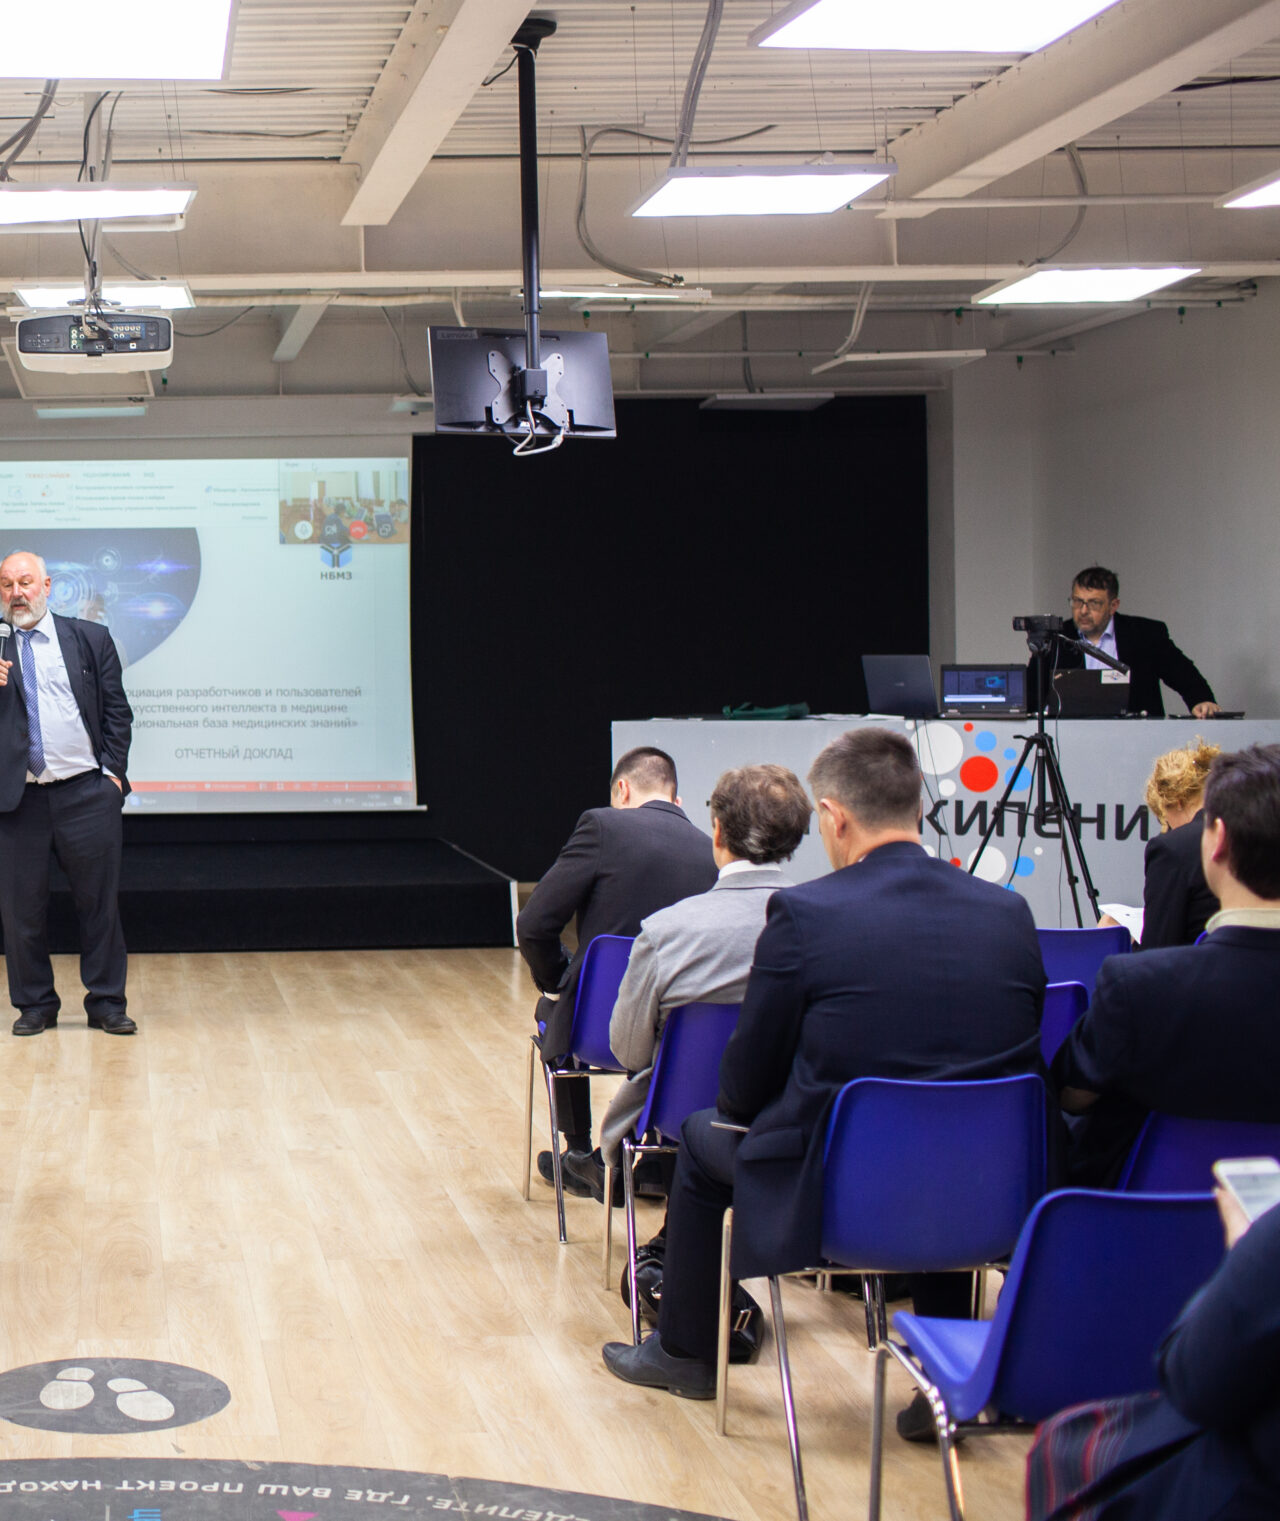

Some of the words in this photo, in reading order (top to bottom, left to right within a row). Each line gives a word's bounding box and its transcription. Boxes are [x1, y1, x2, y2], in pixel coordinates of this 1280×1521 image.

[320, 571, 353, 581] НБМЗ
[126, 688, 173, 700] оциация
[176, 686, 261, 700] разработчиков
[276, 686, 362, 698] пользователей
[133, 703, 208, 715] кусственного
[211, 703, 277, 714] интеллекта
[291, 703, 349, 715] медицине
[132, 718, 199, 731] циональная
[202, 717, 228, 729] база
[232, 718, 307, 731] медицинских
[310, 716, 358, 729] знаний»
[175, 745, 240, 760] ОТЧЕТНЫЙ
[243, 747, 294, 761] ДОКЛАД
[919, 799, 1150, 842] кипени
[115, 1479, 244, 1494] ПРОЕКТ
[257, 1483, 332, 1498] ВАШ
[344, 1489, 410, 1505] ГДЕ
